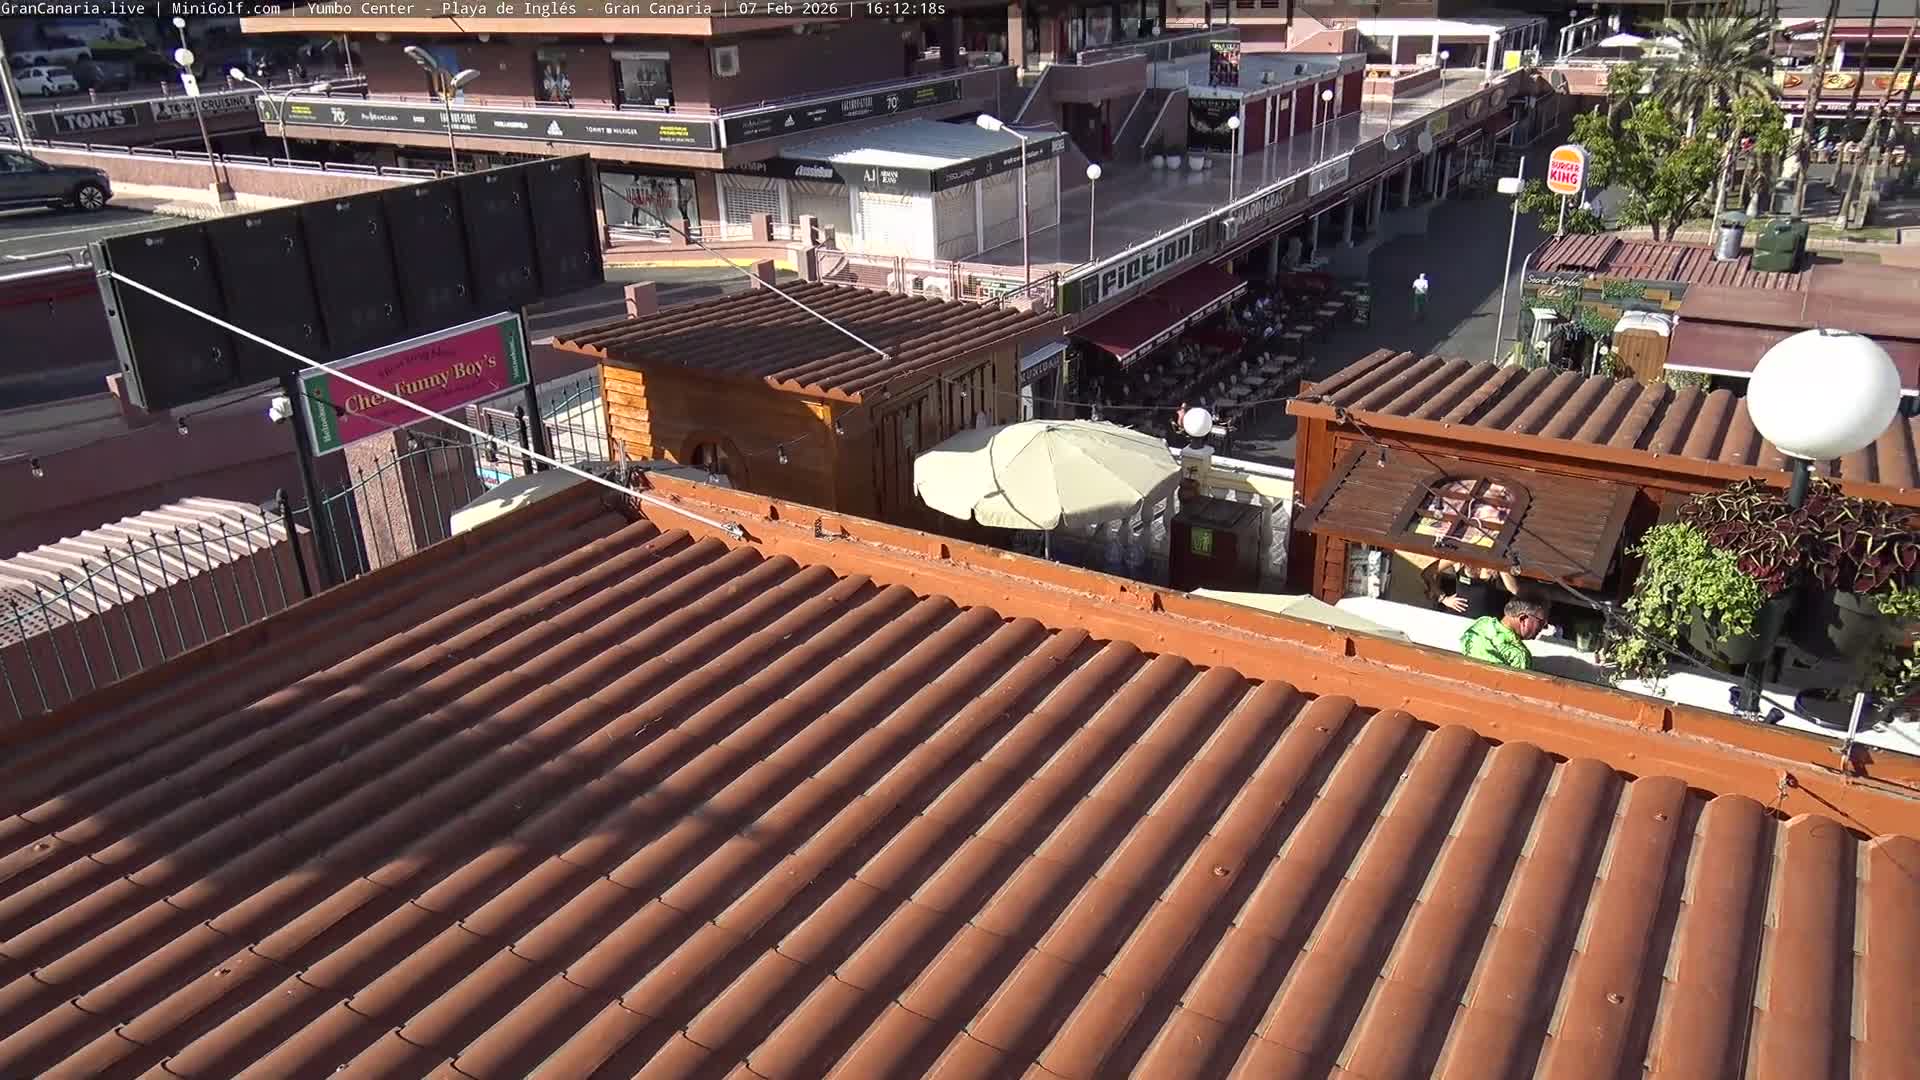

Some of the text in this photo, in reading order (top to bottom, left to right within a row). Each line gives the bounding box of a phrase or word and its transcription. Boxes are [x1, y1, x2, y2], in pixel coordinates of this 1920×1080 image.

[63, 110, 126, 131] TOM'S
[1551, 160, 1581, 172] BURGER
[1550, 170, 1578, 185] KING
[393, 367, 449, 396] Funny
[452, 354, 497, 378] Boy's
